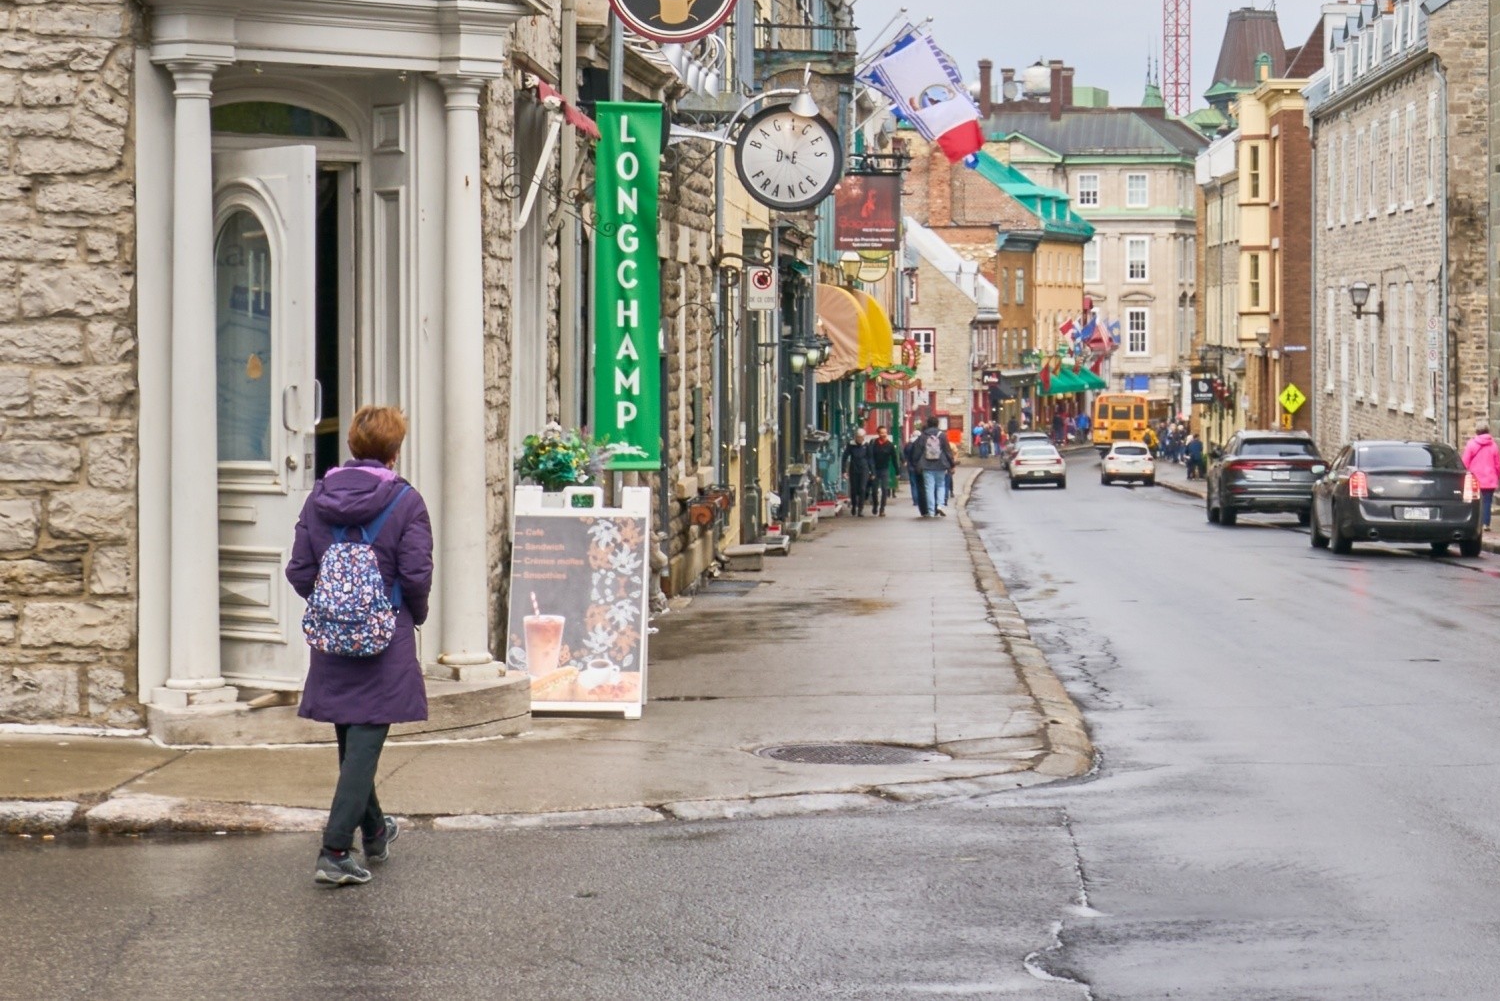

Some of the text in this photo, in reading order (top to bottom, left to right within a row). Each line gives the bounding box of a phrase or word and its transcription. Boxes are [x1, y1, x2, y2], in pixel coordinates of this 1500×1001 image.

[776, 149, 798, 165] DE
[752, 175, 818, 198] FRANCE
[614, 115, 640, 429] LONGCHAMP
[525, 543, 565, 551] Sandwich
